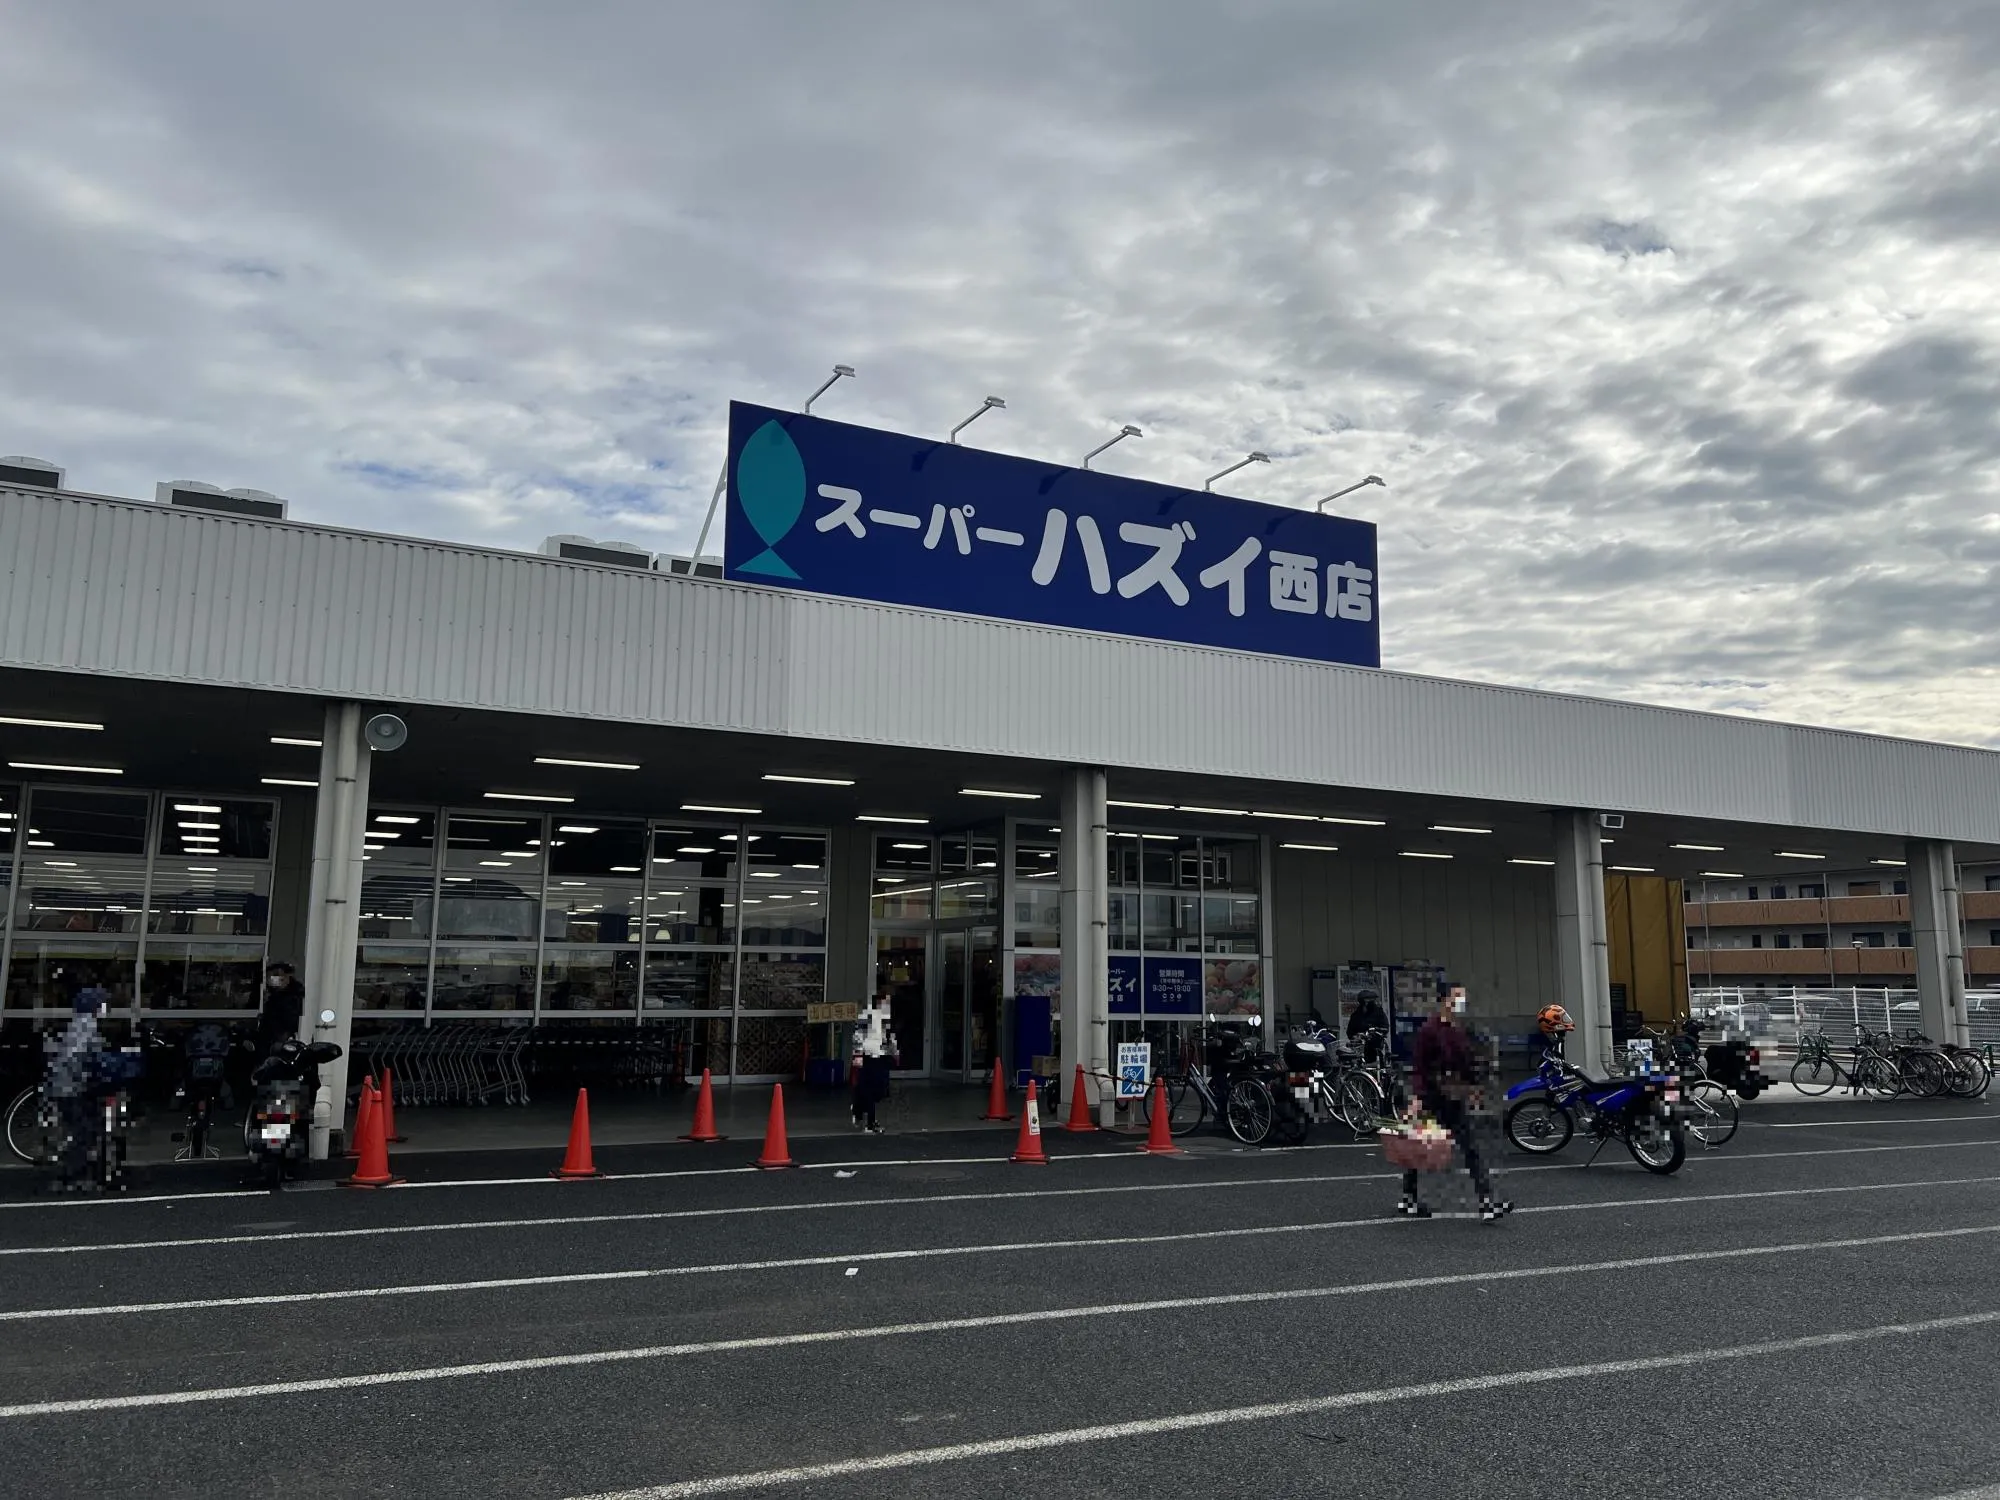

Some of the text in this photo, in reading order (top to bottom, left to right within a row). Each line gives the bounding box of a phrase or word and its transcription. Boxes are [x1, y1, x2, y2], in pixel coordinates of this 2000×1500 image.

[815, 484, 1372, 621] スーパーハズイ西店
[1120, 1054, 1147, 1064] 駐輪場
